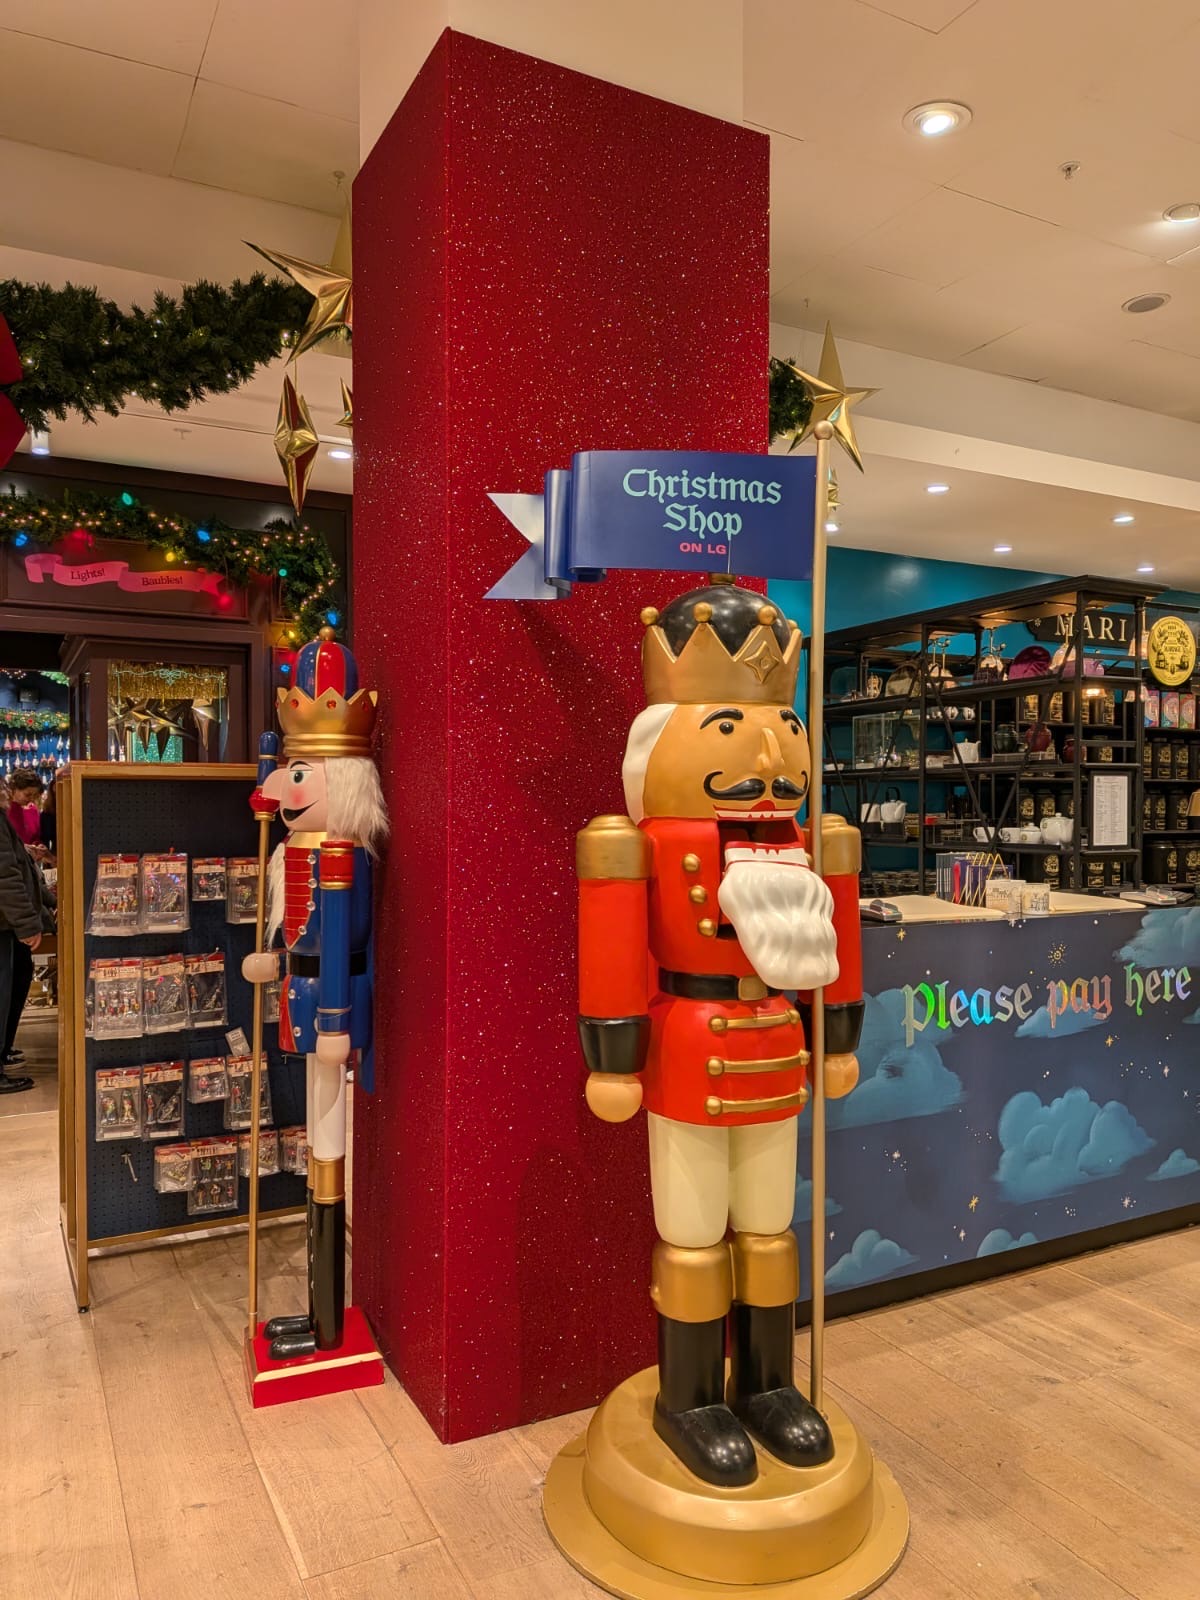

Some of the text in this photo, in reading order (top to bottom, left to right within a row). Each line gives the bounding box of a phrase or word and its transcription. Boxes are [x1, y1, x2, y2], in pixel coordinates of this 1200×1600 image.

[622, 468, 783, 505] Christmas
[662, 502, 743, 541] Shop
[679, 542, 727, 555] ON LG
[70, 568, 105, 582] Lights!
[142, 576, 184, 587] Baubles!
[1046, 974, 1113, 1029] pay
[1123, 962, 1192, 1016] here
